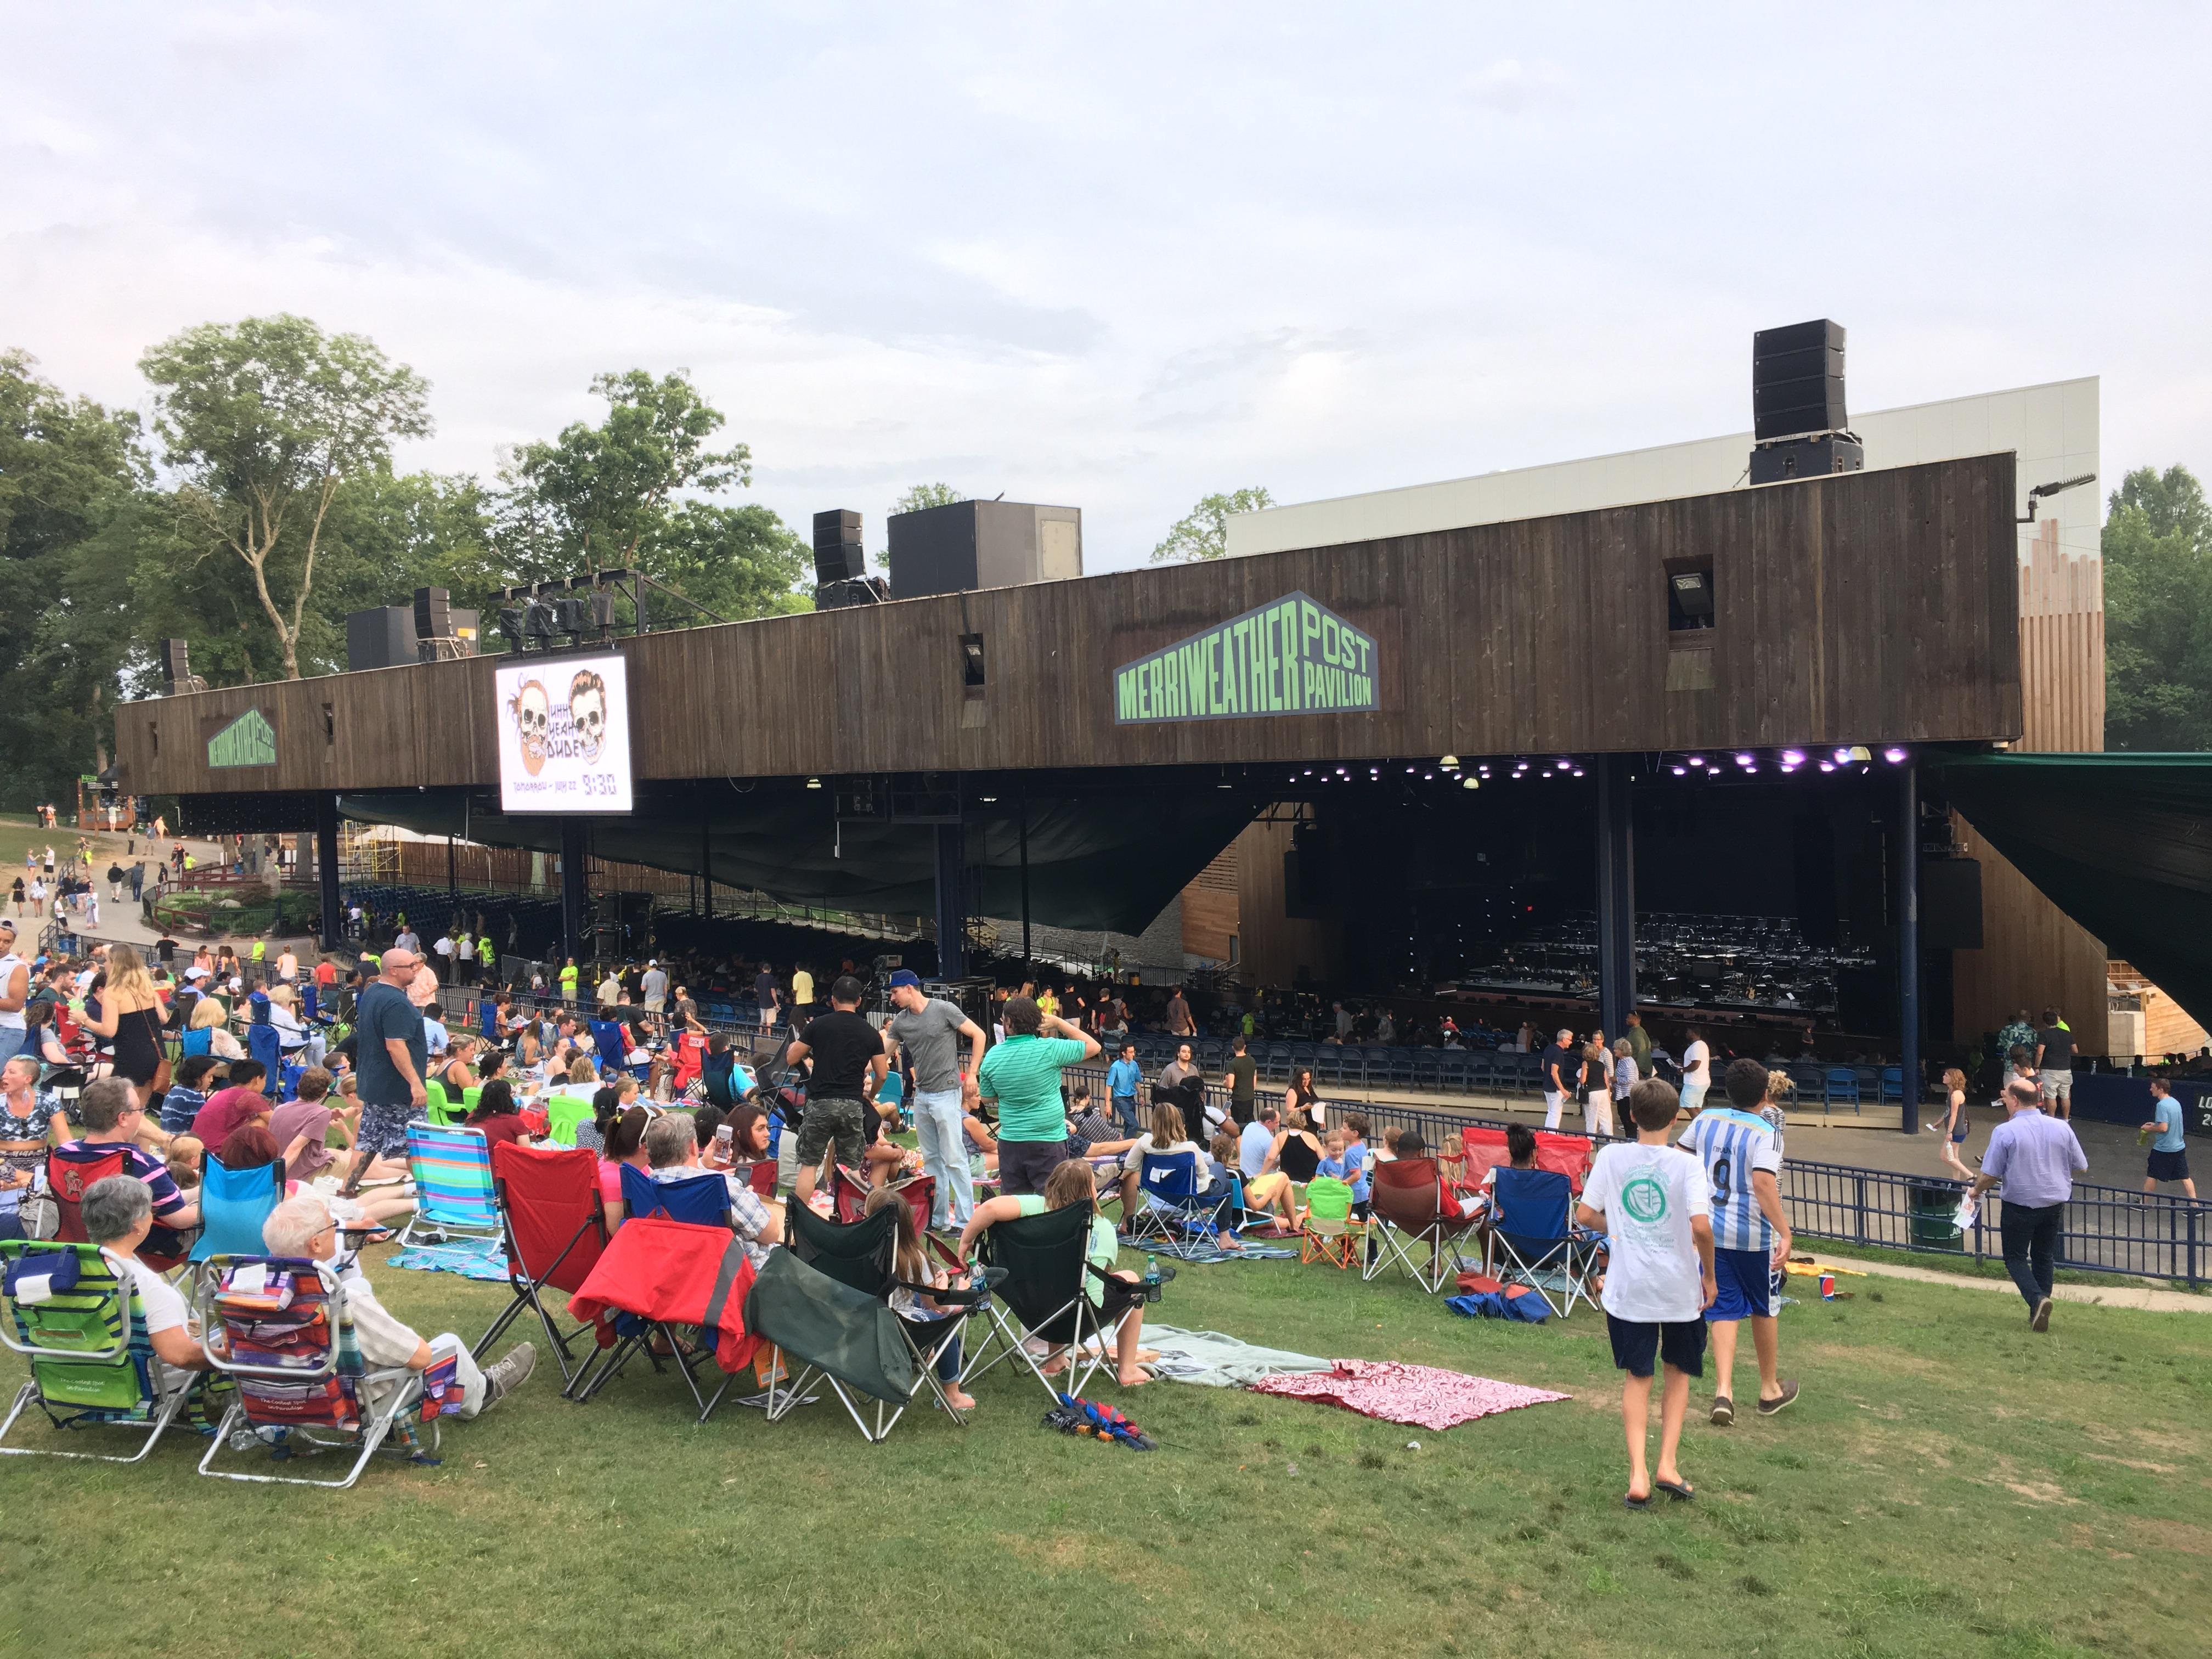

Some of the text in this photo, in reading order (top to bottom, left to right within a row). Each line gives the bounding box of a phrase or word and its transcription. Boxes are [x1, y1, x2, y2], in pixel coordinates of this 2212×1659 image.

[1119, 600, 1300, 720] MERRIWEATHER
[1301, 599, 1370, 673] POST
[1304, 660, 1372, 709] PAVILION
[547, 740, 580, 758] DUDE
[568, 781, 577, 790] 22
[583, 774, 617, 795] 9:30
[1710, 1158, 1731, 1207] 9
